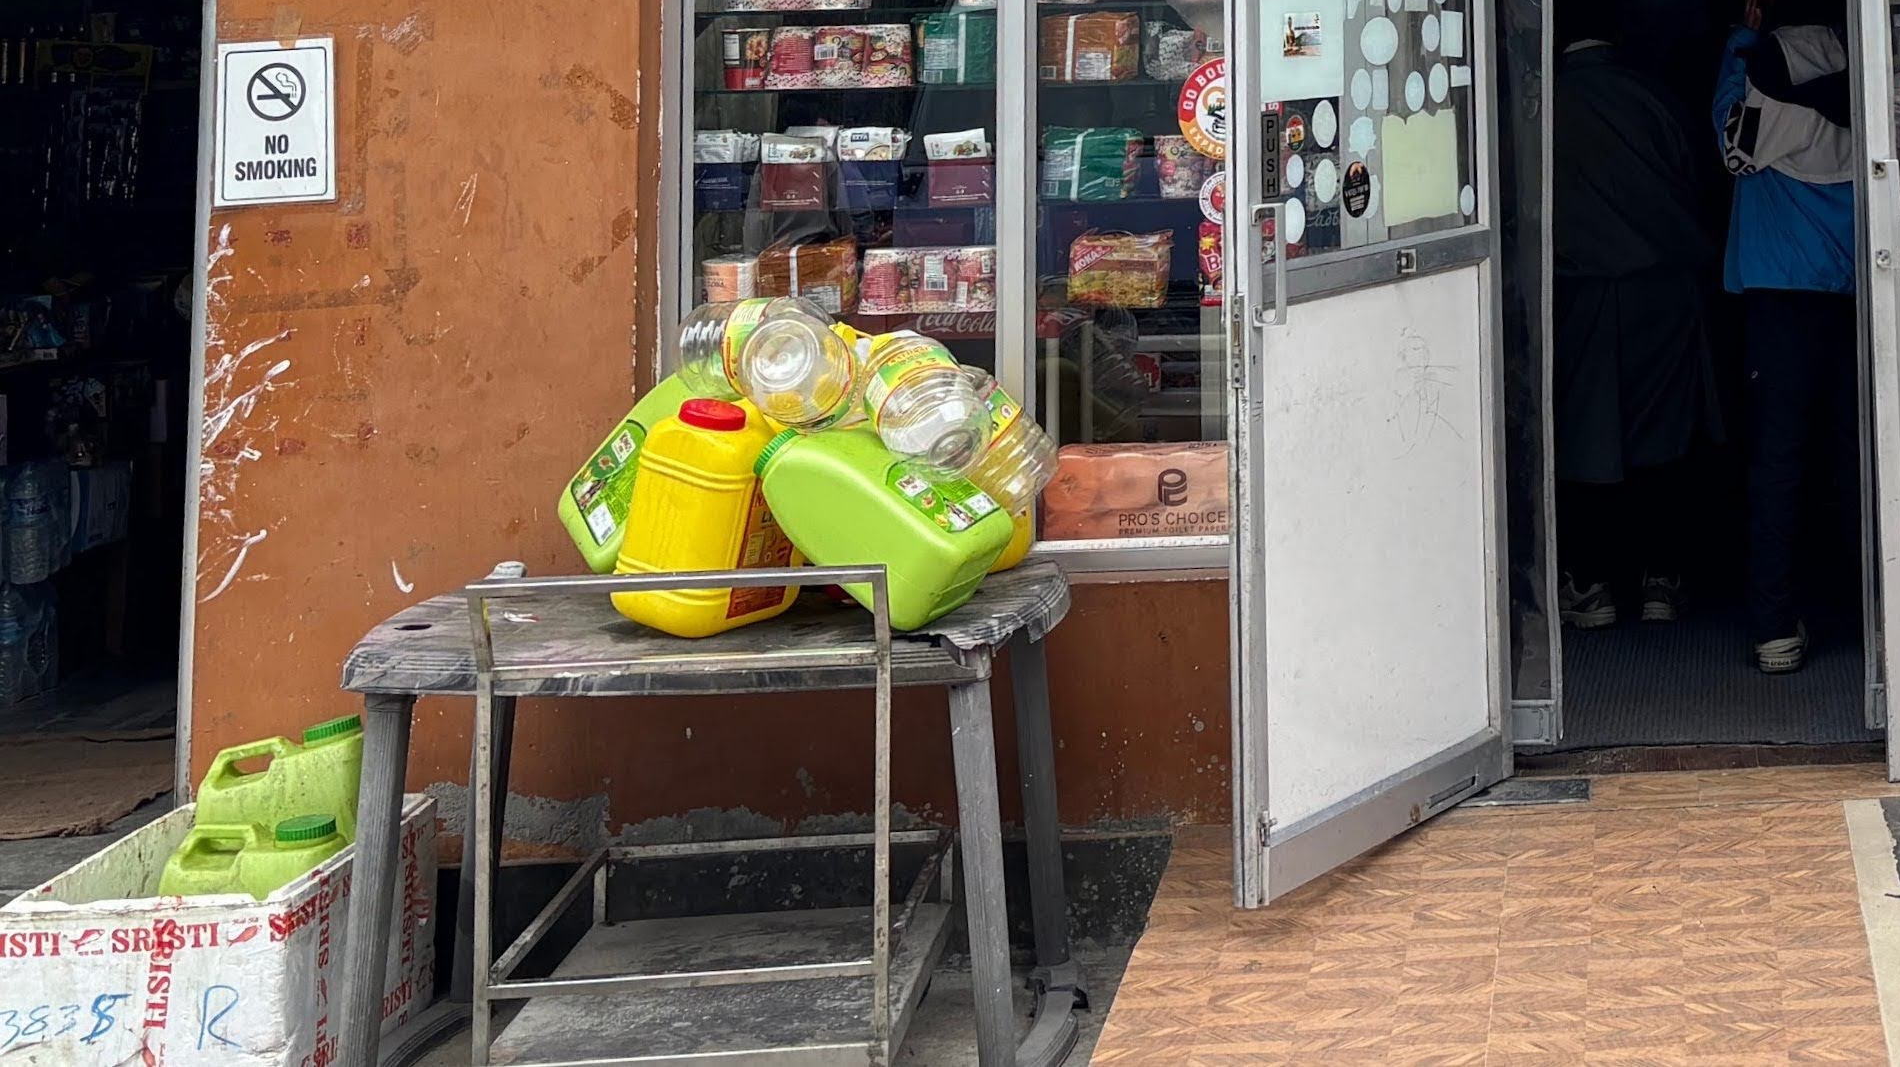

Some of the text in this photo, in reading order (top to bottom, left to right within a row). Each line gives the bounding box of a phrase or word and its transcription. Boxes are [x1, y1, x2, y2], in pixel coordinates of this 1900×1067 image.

[1182, 89, 1198, 111] GO
[264, 134, 290, 156] NO
[1266, 119, 1277, 194] PUSH
[234, 158, 318, 182] SMOKING
[1073, 251, 1100, 272] KOKA
[1118, 510, 1227, 527] PRO'S CHOICE
[1118, 525, 1227, 535] PREMIUM TOILET PAPER
[111, 922, 220, 954] SRISTI
[197, 984, 242, 1051] R
